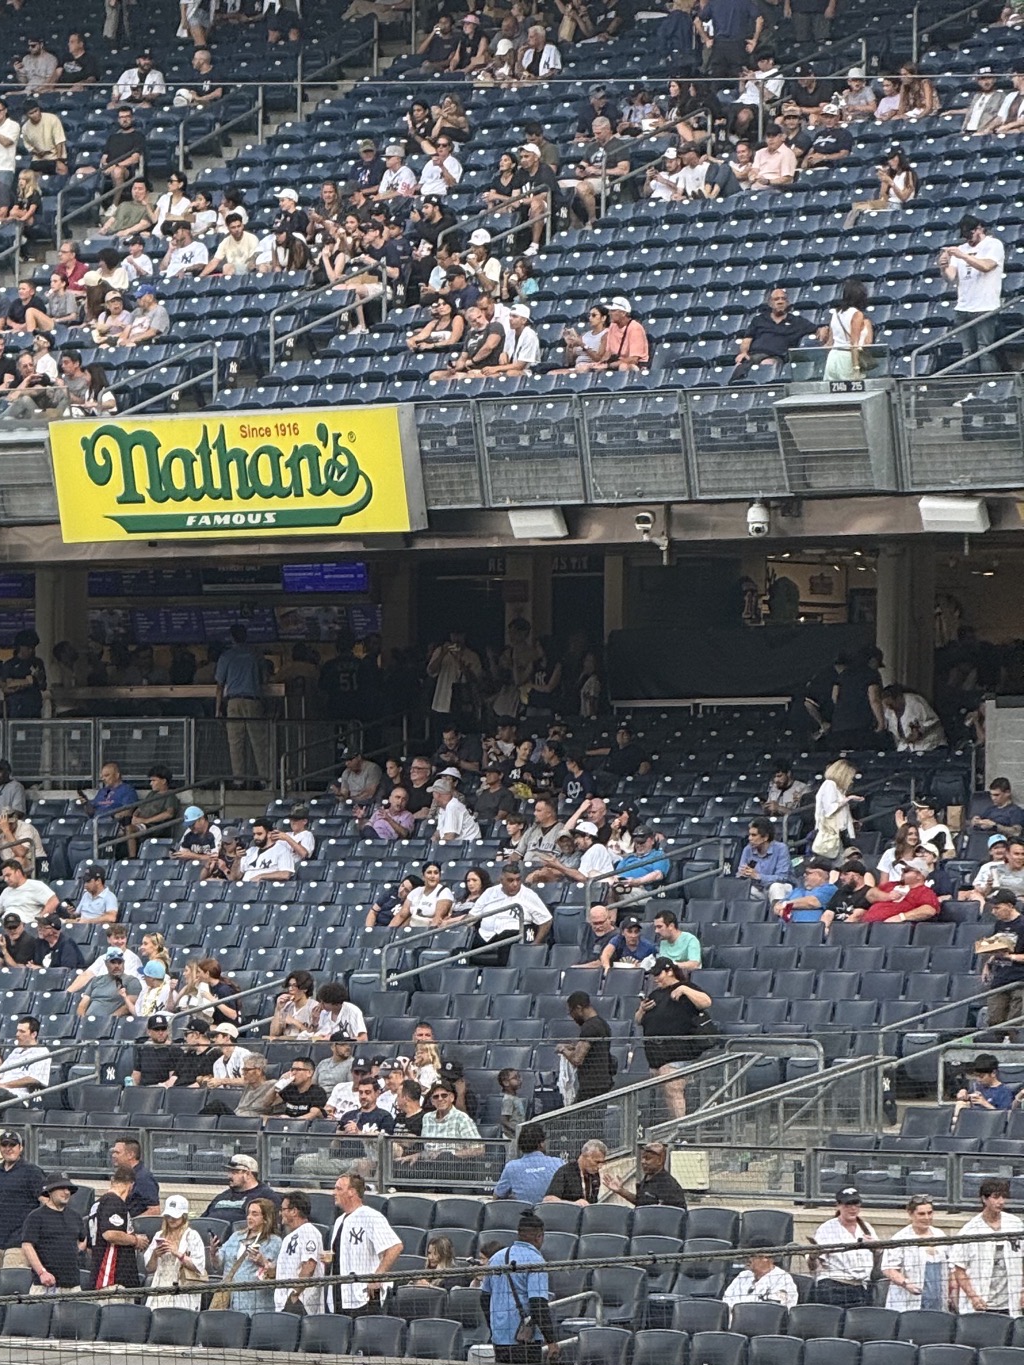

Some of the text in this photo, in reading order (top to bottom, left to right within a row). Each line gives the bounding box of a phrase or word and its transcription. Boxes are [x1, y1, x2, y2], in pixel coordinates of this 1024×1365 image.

[181, 252, 195, 264] NY
[239, 422, 300, 439] Since 1916
[81, 422, 373, 505] Nathan's
[186, 512, 278, 527] FAMOUS
[339, 672, 358, 692] 51
[259, 858, 273, 870] NY
[105, 1066, 116, 1080] NY
[348, 1226, 366, 1246] NY
